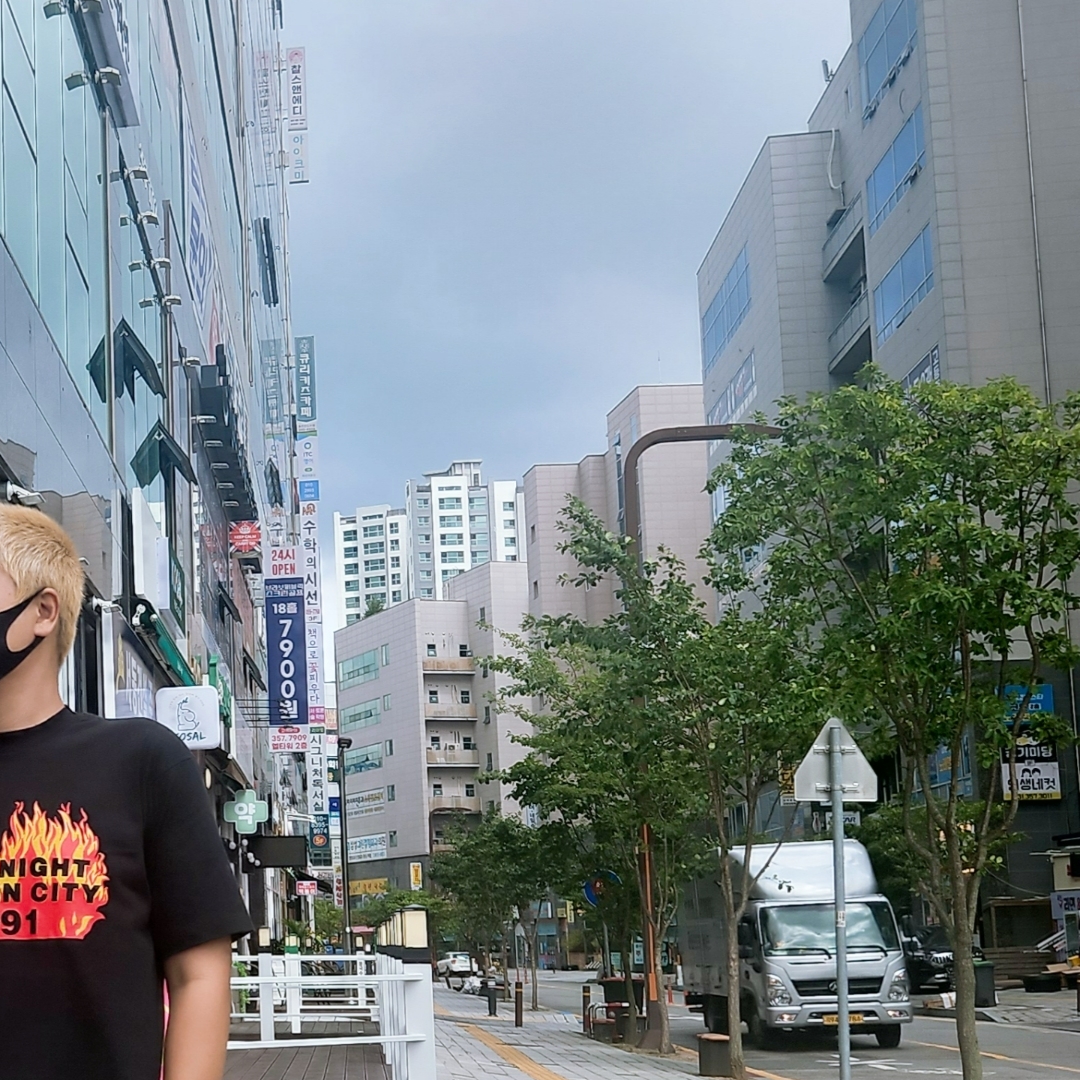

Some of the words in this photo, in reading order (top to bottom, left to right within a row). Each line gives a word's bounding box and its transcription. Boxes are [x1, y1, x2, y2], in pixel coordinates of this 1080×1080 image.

[272, 549, 295, 561] 24시
[303, 520, 318, 606] 수학의시선
[272, 563, 296, 576] OPEN
[176, 731, 207, 741] OSAL
[234, 802, 256, 825] 약
[30, 882, 101, 904] CITY
